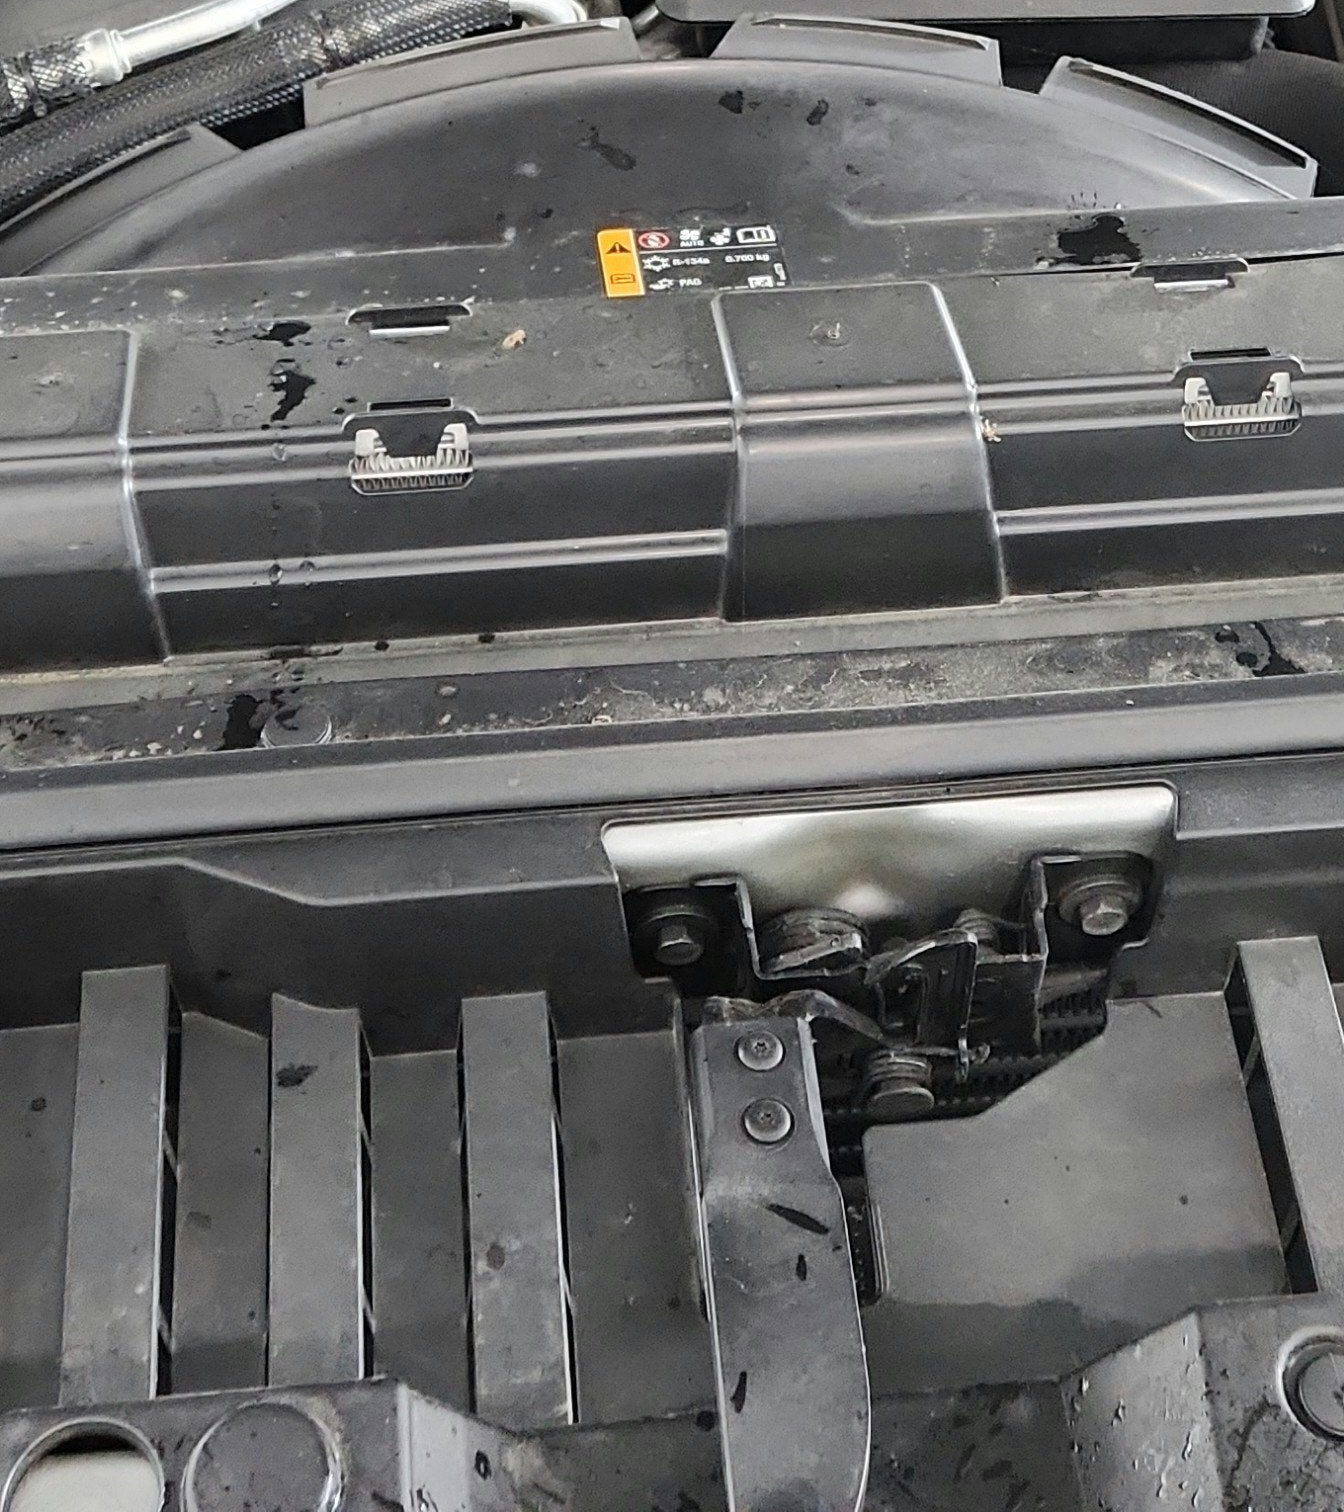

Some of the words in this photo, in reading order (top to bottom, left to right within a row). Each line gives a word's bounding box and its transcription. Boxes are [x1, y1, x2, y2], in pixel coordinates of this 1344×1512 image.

[680, 240, 705, 248] AUTO
[755, 253, 770, 262] kg
[678, 277, 703, 287] PAG
